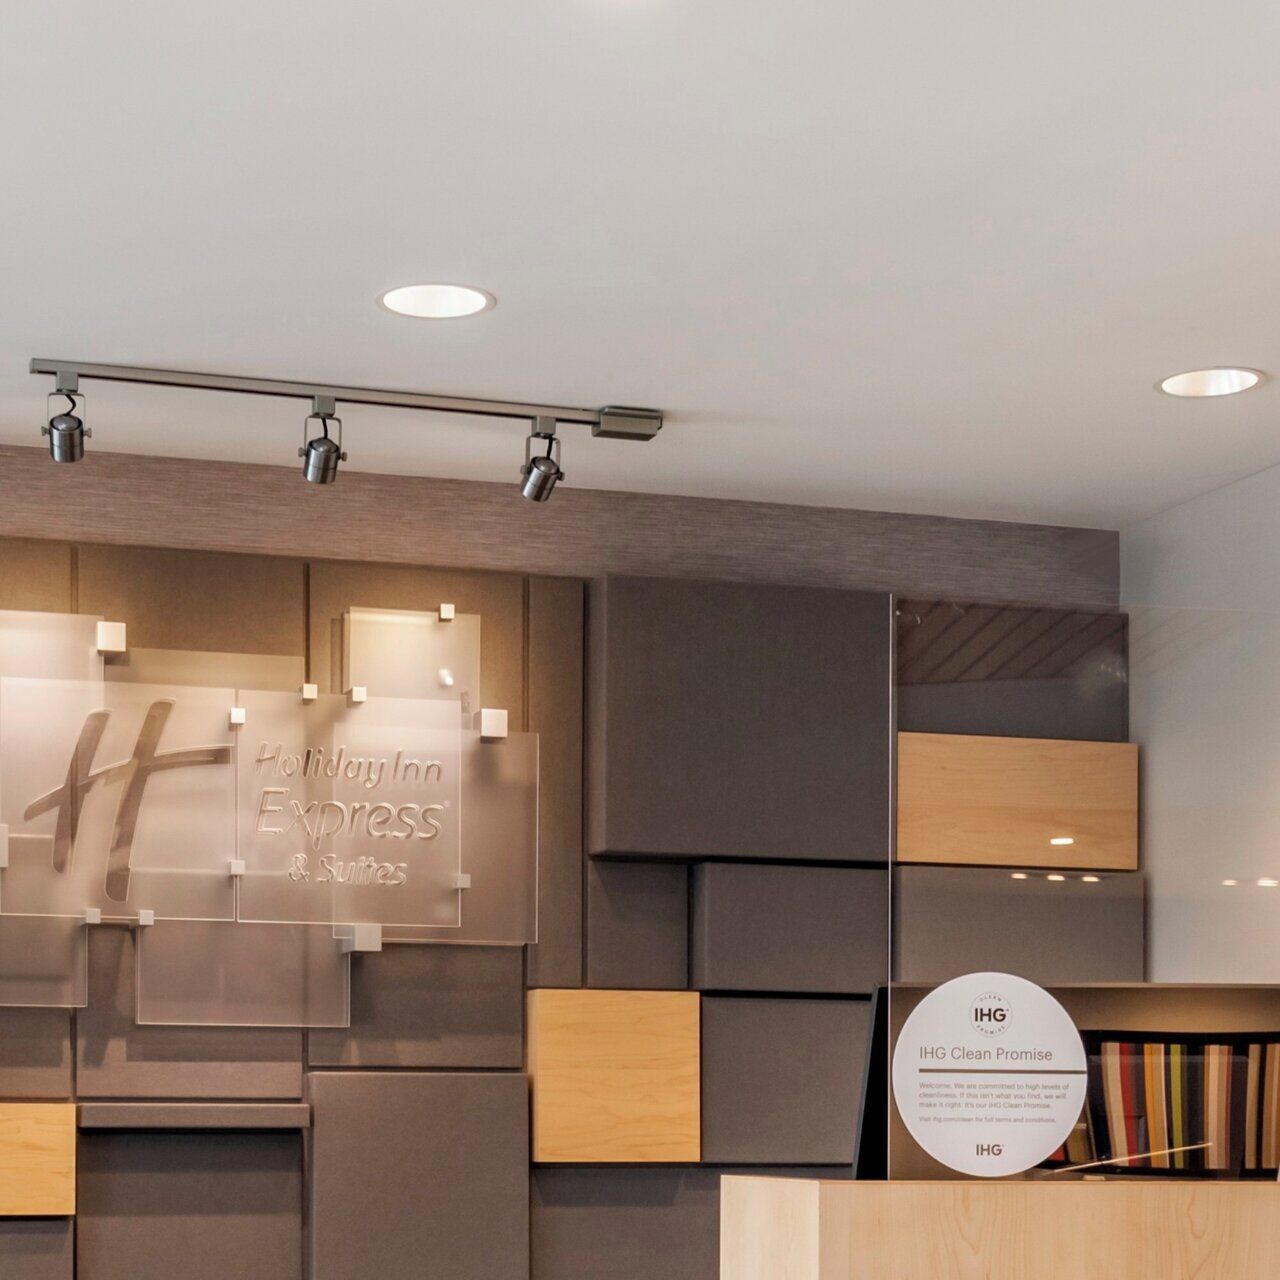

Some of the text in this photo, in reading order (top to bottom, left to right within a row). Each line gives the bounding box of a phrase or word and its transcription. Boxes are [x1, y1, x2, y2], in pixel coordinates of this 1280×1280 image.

[256, 742, 442, 788] Holiday Inn
[255, 787, 445, 850] Express
[288, 853, 408, 886] & Suites
[974, 1008, 1007, 1022] IHG
[920, 1046, 1053, 1061] IHG Clean Promise
[1025, 1083, 1040, 1091] high
[976, 1144, 1003, 1156] IHG
